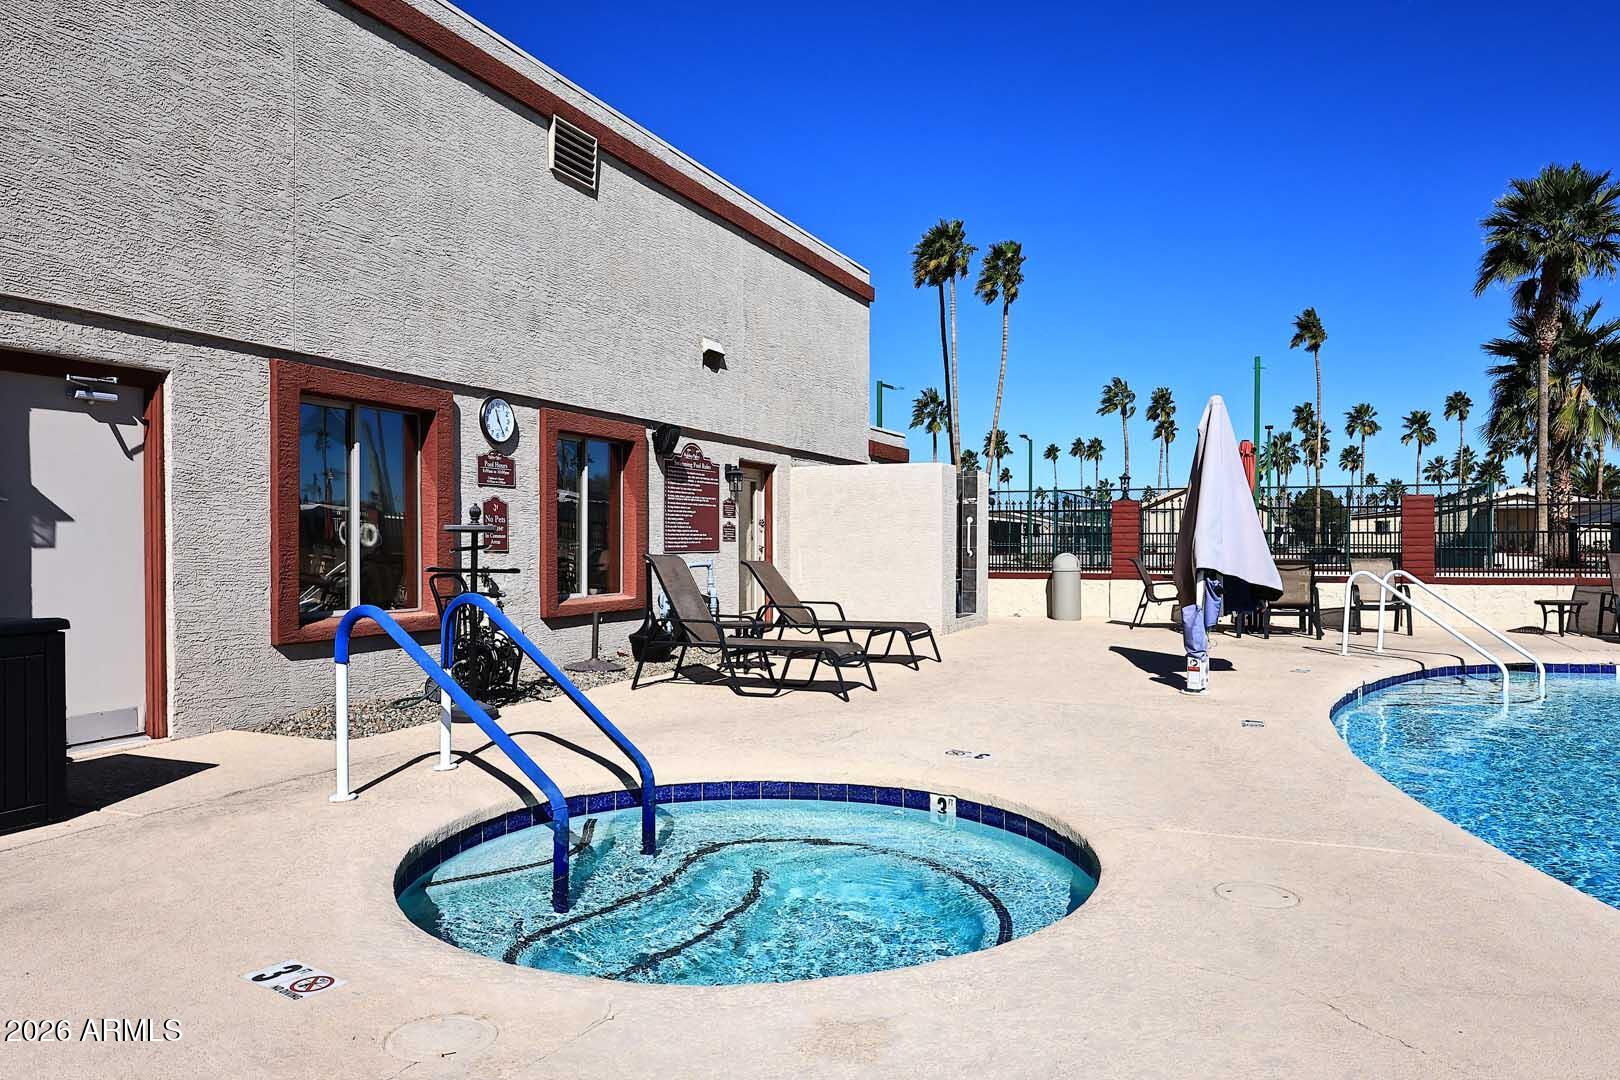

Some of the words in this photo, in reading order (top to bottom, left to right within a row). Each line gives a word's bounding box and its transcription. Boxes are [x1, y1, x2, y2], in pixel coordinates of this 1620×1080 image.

[484, 460, 494, 468] Pool
[494, 461, 508, 469] Hours
[485, 514, 494, 523] No
[494, 515, 506, 524] Pets
[937, 797, 947, 814] 3
[251, 964, 303, 982] 3
